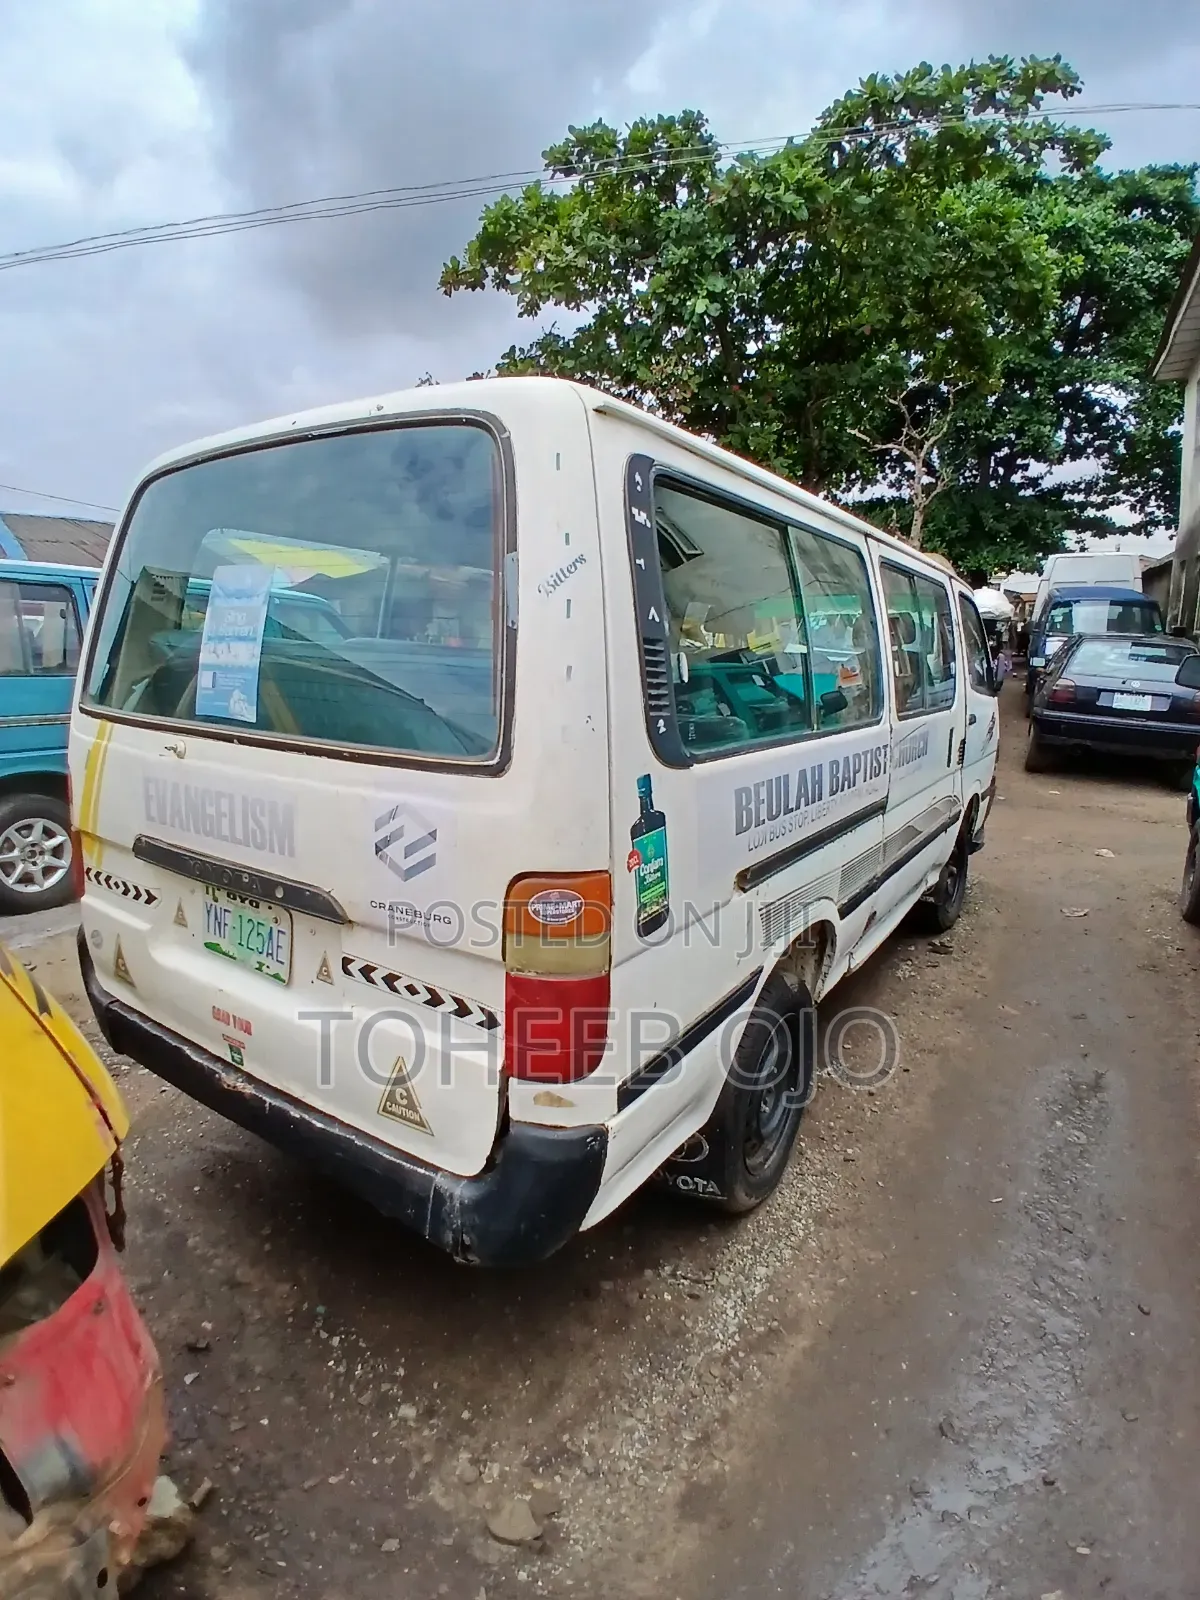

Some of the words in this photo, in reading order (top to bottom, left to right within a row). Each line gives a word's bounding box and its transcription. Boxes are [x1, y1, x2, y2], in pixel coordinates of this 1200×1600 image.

[734, 763, 824, 836] BEULAH
[829, 744, 889, 797] BAPTIST
[144, 777, 296, 858] EVANGELISM
[370, 900, 452, 925] CRANEBURG
[395, 1087, 408, 1105] C
[386, 1101, 421, 1122] CAUTION
